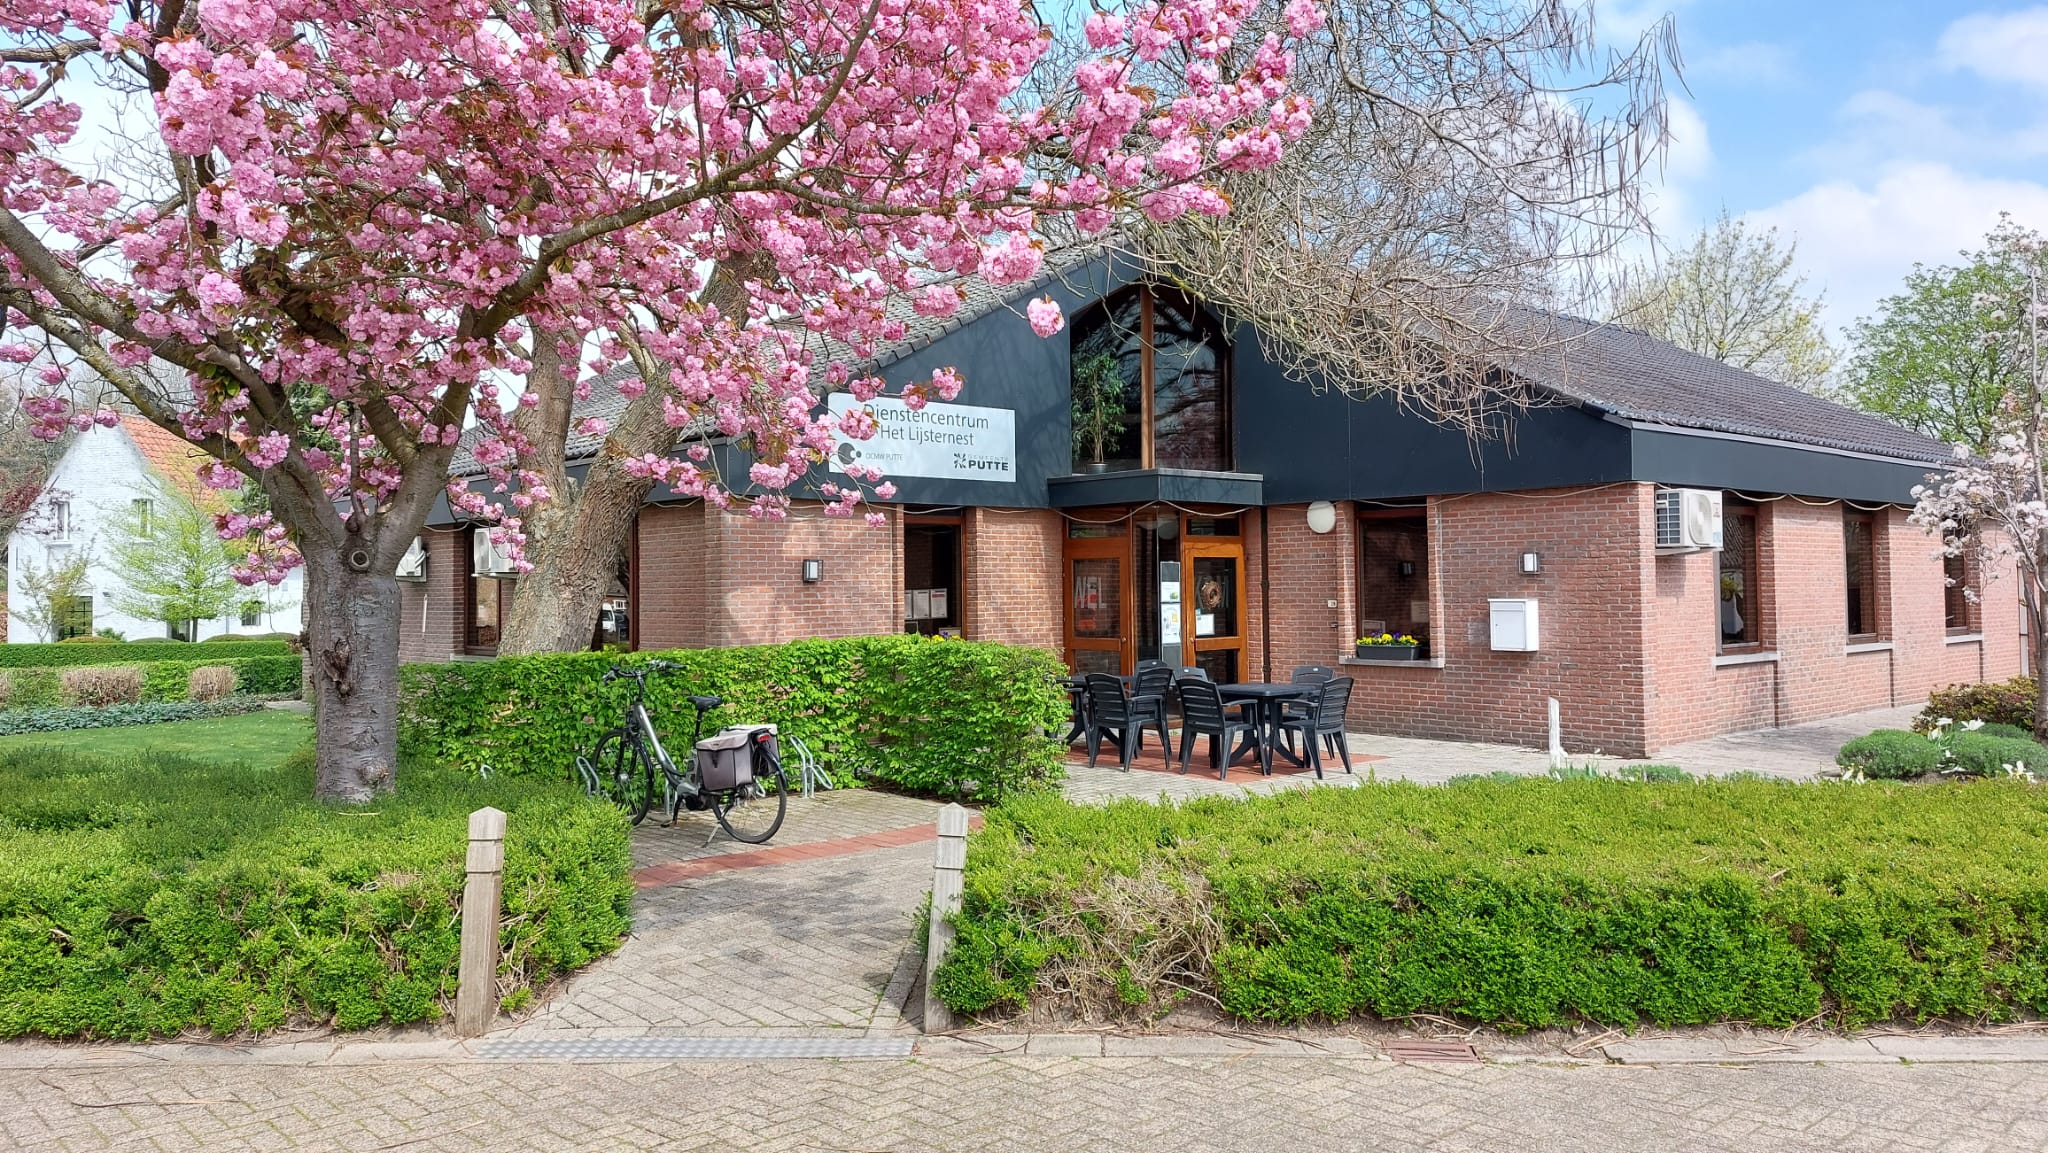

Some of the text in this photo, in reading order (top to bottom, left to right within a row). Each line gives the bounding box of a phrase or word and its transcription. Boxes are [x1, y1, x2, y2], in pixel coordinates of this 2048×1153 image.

[880, 424, 974, 446] Het Lijsternest
[886, 453, 904, 461] PUTTE
[968, 460, 1009, 471] PUTTE
